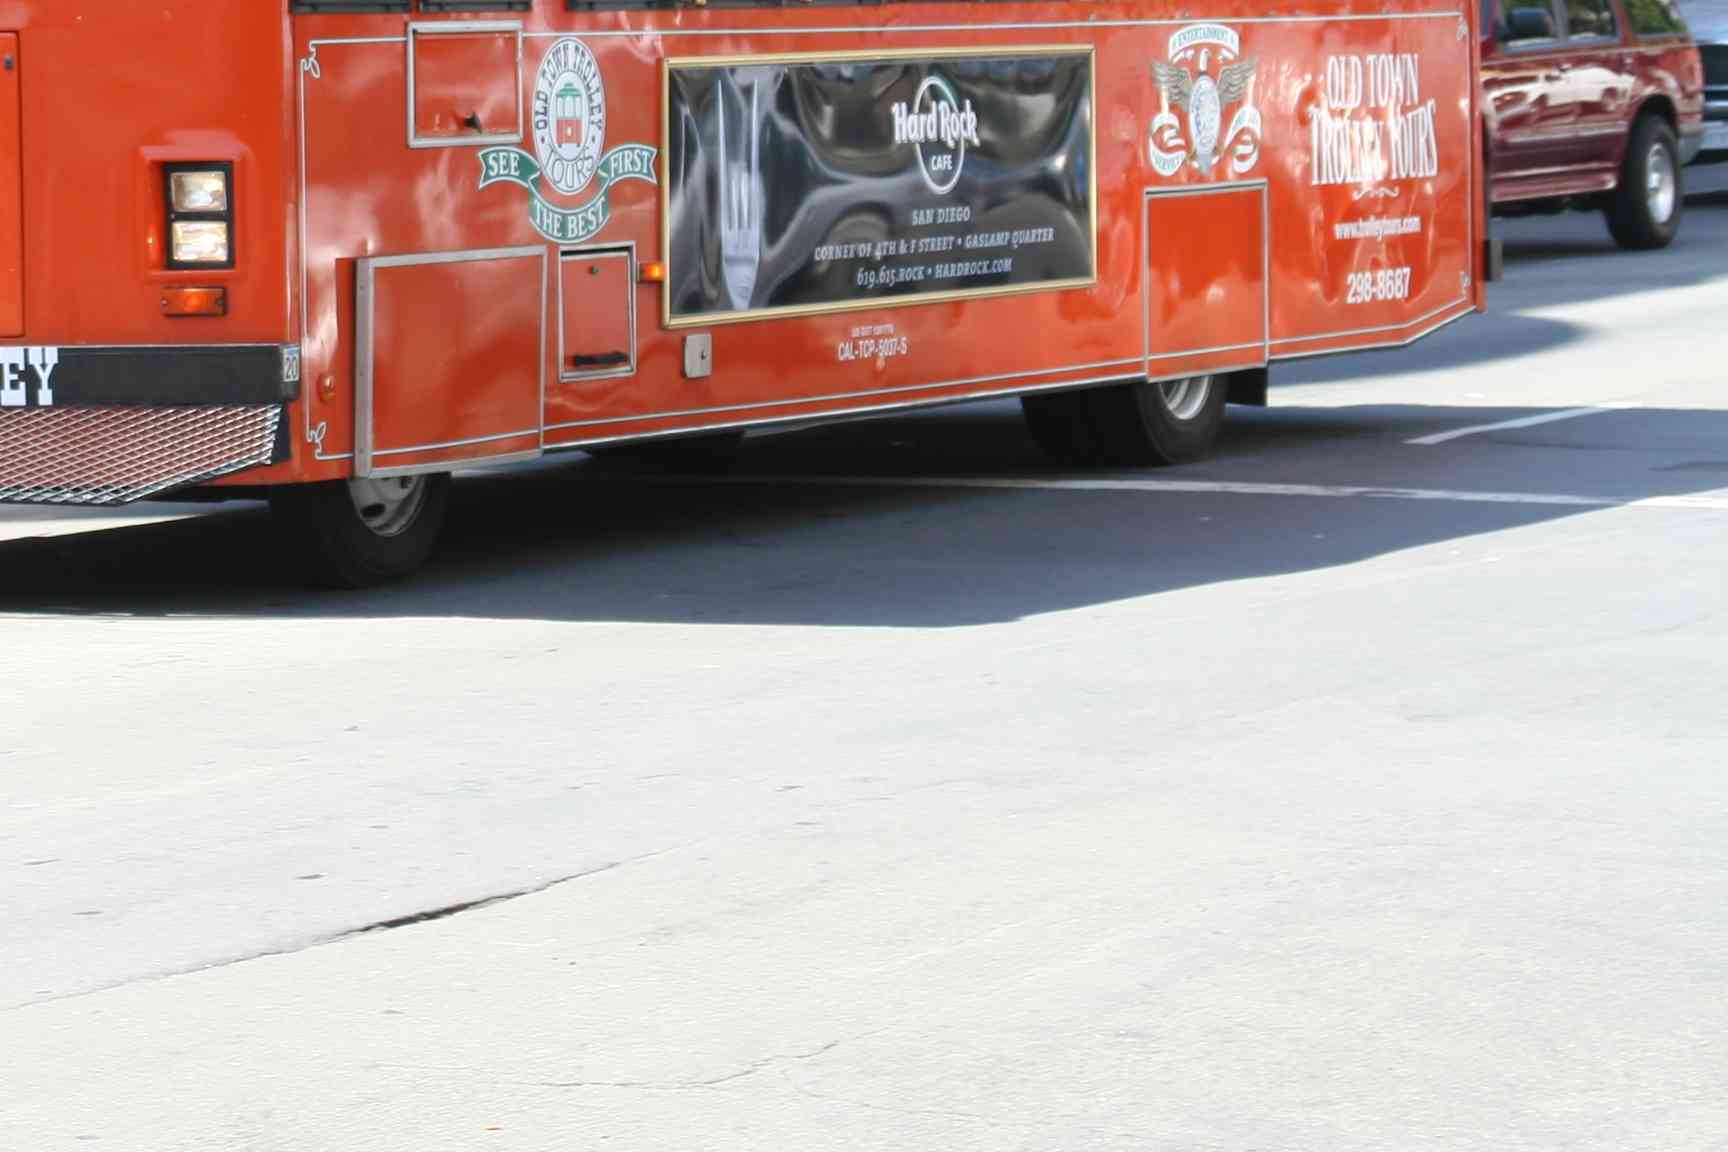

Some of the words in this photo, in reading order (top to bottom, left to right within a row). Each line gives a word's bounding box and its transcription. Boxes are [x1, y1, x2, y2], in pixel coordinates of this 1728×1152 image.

[535, 89, 548, 130] OLD
[574, 44, 602, 130] TROLLEY
[1327, 55, 1363, 109] OLD
[1366, 52, 1419, 108] TOWN
[891, 100, 938, 144] Hard
[938, 98, 981, 149] Rock
[1389, 98, 1439, 179] TOURS
[547, 146, 595, 188] TOURS
[931, 154, 953, 171] CAFE
[488, 151, 520, 176] SEE
[534, 199, 563, 237] THE
[567, 196, 607, 238] BEST
[610, 150, 652, 174] FIRST
[912, 208, 934, 226] SAN
[936, 206, 971, 224] DIEGO
[814, 245, 856, 261] CORNER
[859, 243, 873, 257] OF
[874, 241, 897, 261] 4TH
[899, 239, 909, 254] &
[918, 236, 955, 253] STREET
[965, 231, 1010, 248] GASLAMP
[1012, 227, 1055, 249] QUARTER
[935, 257, 1013, 279] HARDROCK.COM
[1346, 266, 1412, 304] 298-8687
